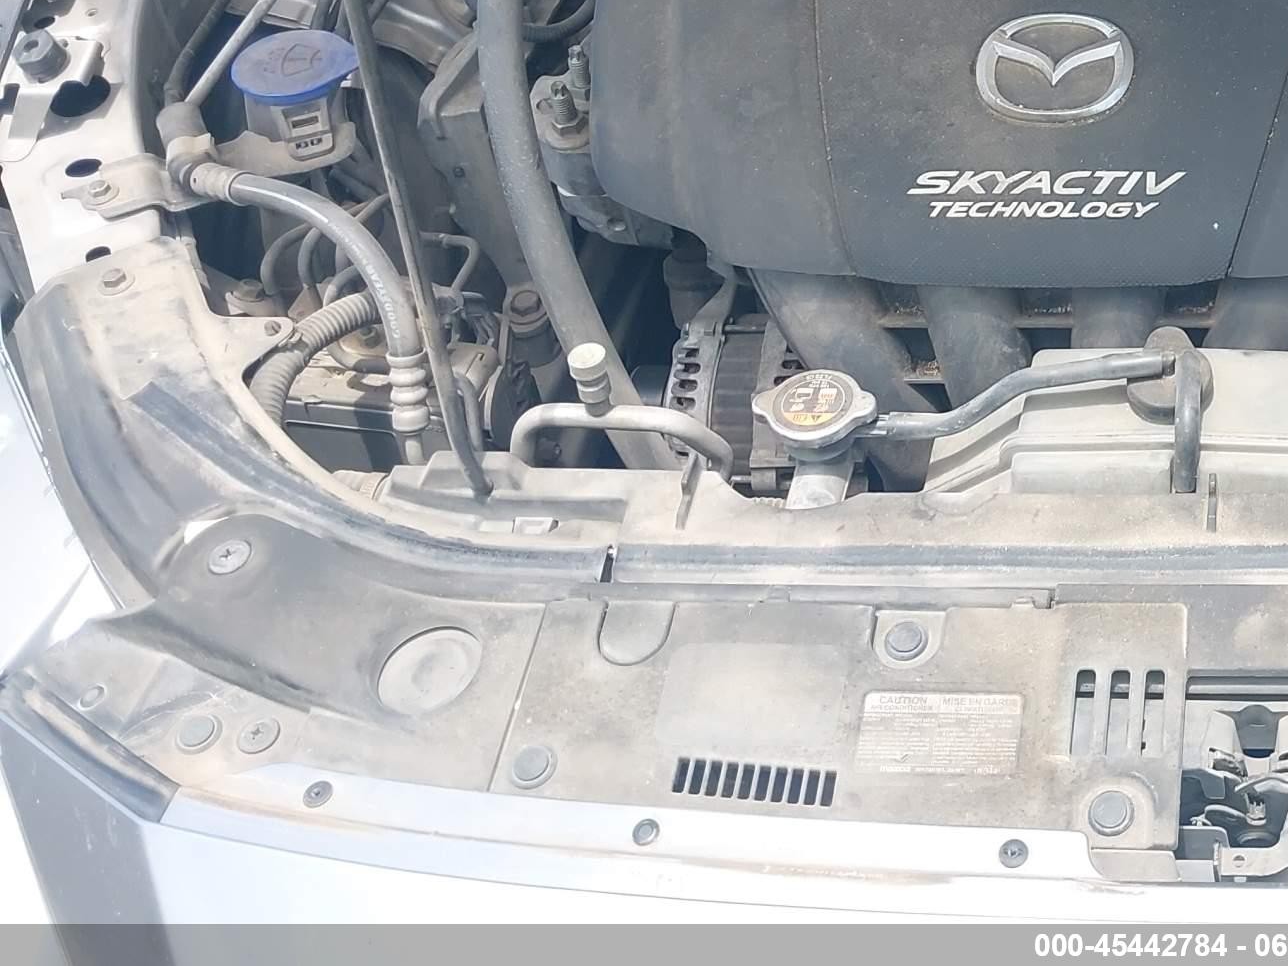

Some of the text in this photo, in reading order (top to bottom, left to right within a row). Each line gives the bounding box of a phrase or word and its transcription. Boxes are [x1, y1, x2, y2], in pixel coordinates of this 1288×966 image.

[907, 170, 1188, 196] SKYACTIV
[928, 201, 1160, 219] TECHNOLOGY
[365, 265, 400, 338] GOODYEAR
[879, 695, 928, 705] CAUTION
[942, 696, 967, 706] MISE
